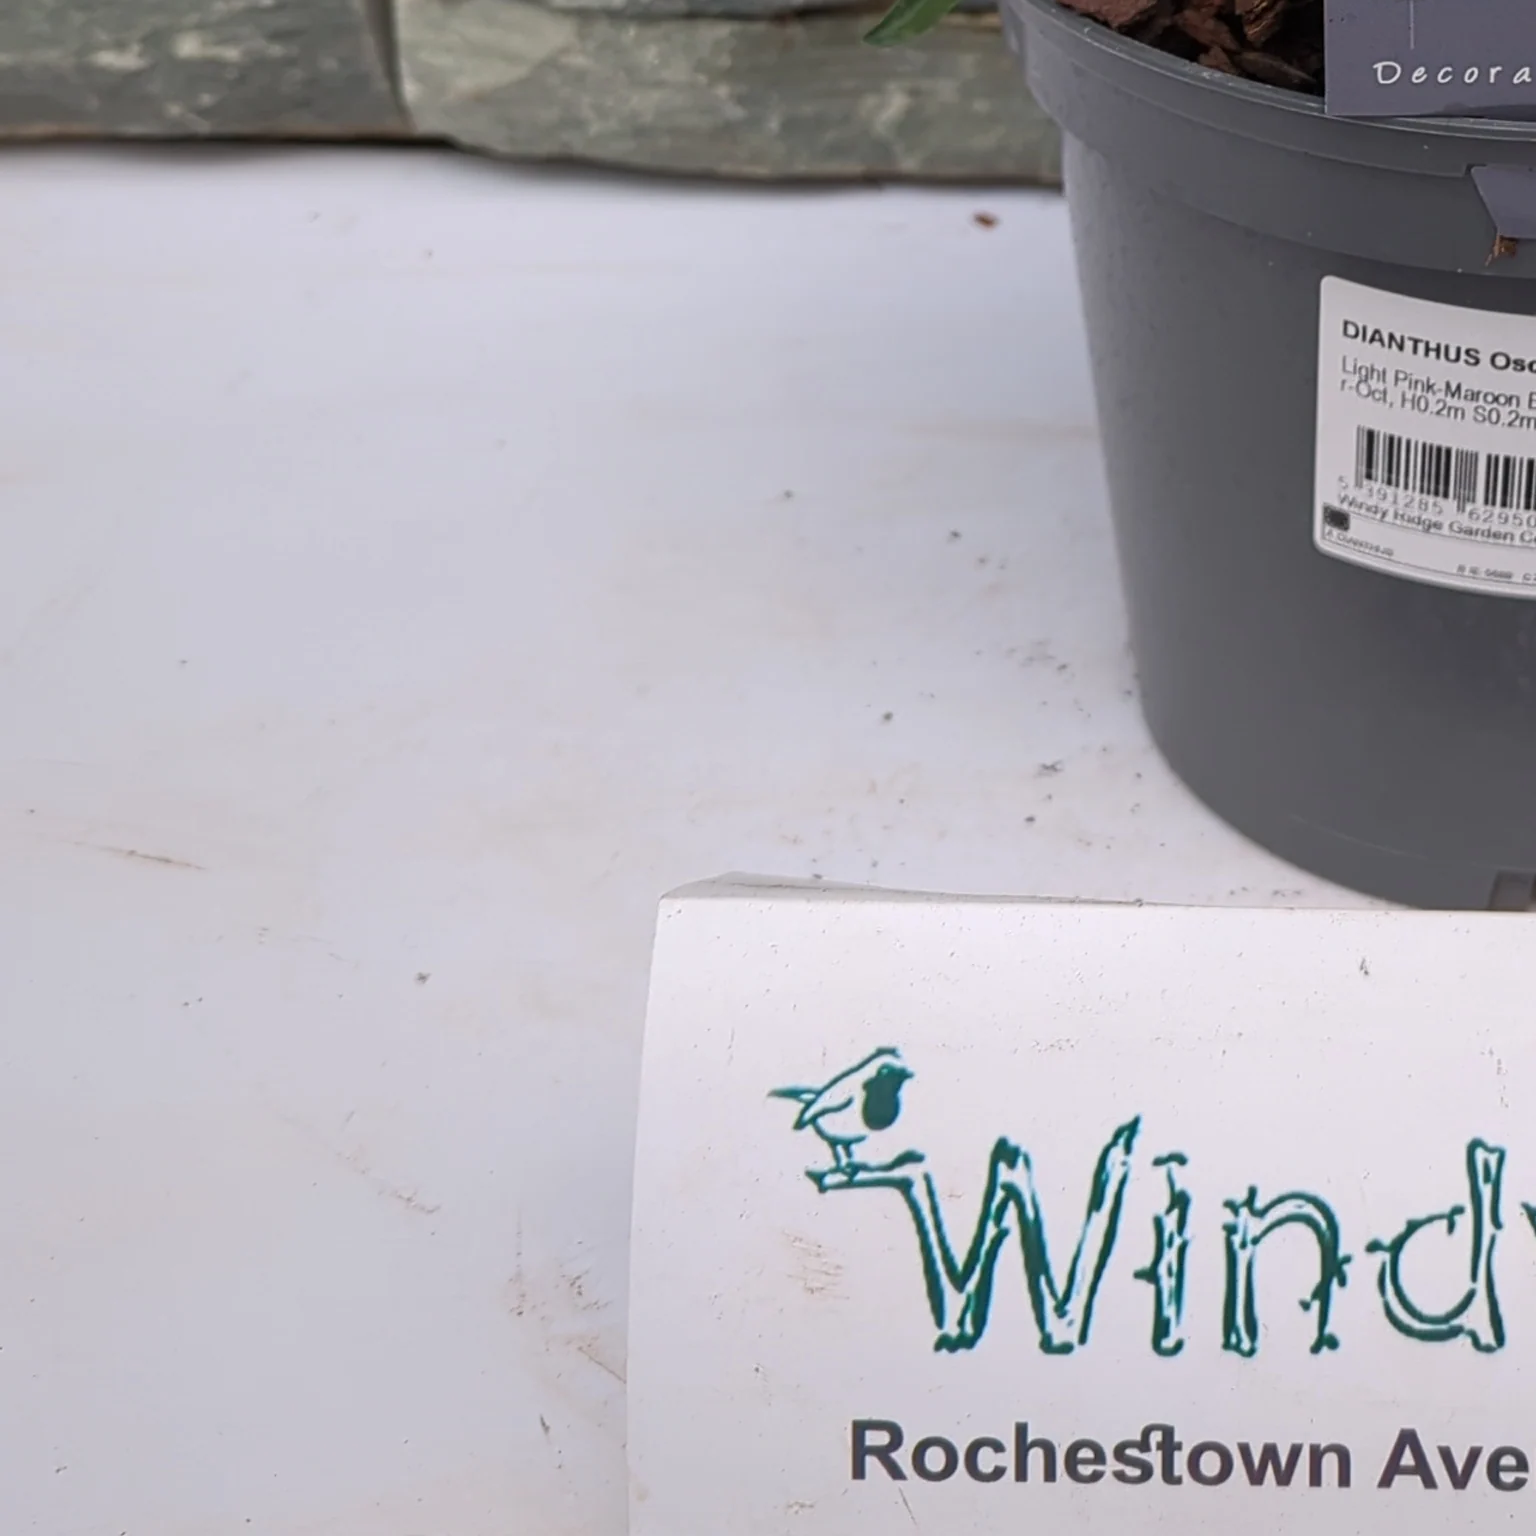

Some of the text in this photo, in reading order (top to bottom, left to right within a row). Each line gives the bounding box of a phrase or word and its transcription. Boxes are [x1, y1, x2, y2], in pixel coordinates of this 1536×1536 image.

[1342, 319, 1481, 367] DIANTHUS
[1340, 377, 1394, 407] r-Oct,
[1401, 391, 1466, 421] H0.2m
[1341, 355, 1387, 385] Light
[1394, 369, 1521, 408] Pink-Maroon
[1338, 493, 1388, 521] Windy
[1450, 520, 1515, 544] Garden
[1364, 482, 1444, 516] 391285
[850, 1419, 1352, 1489] Rochestown
